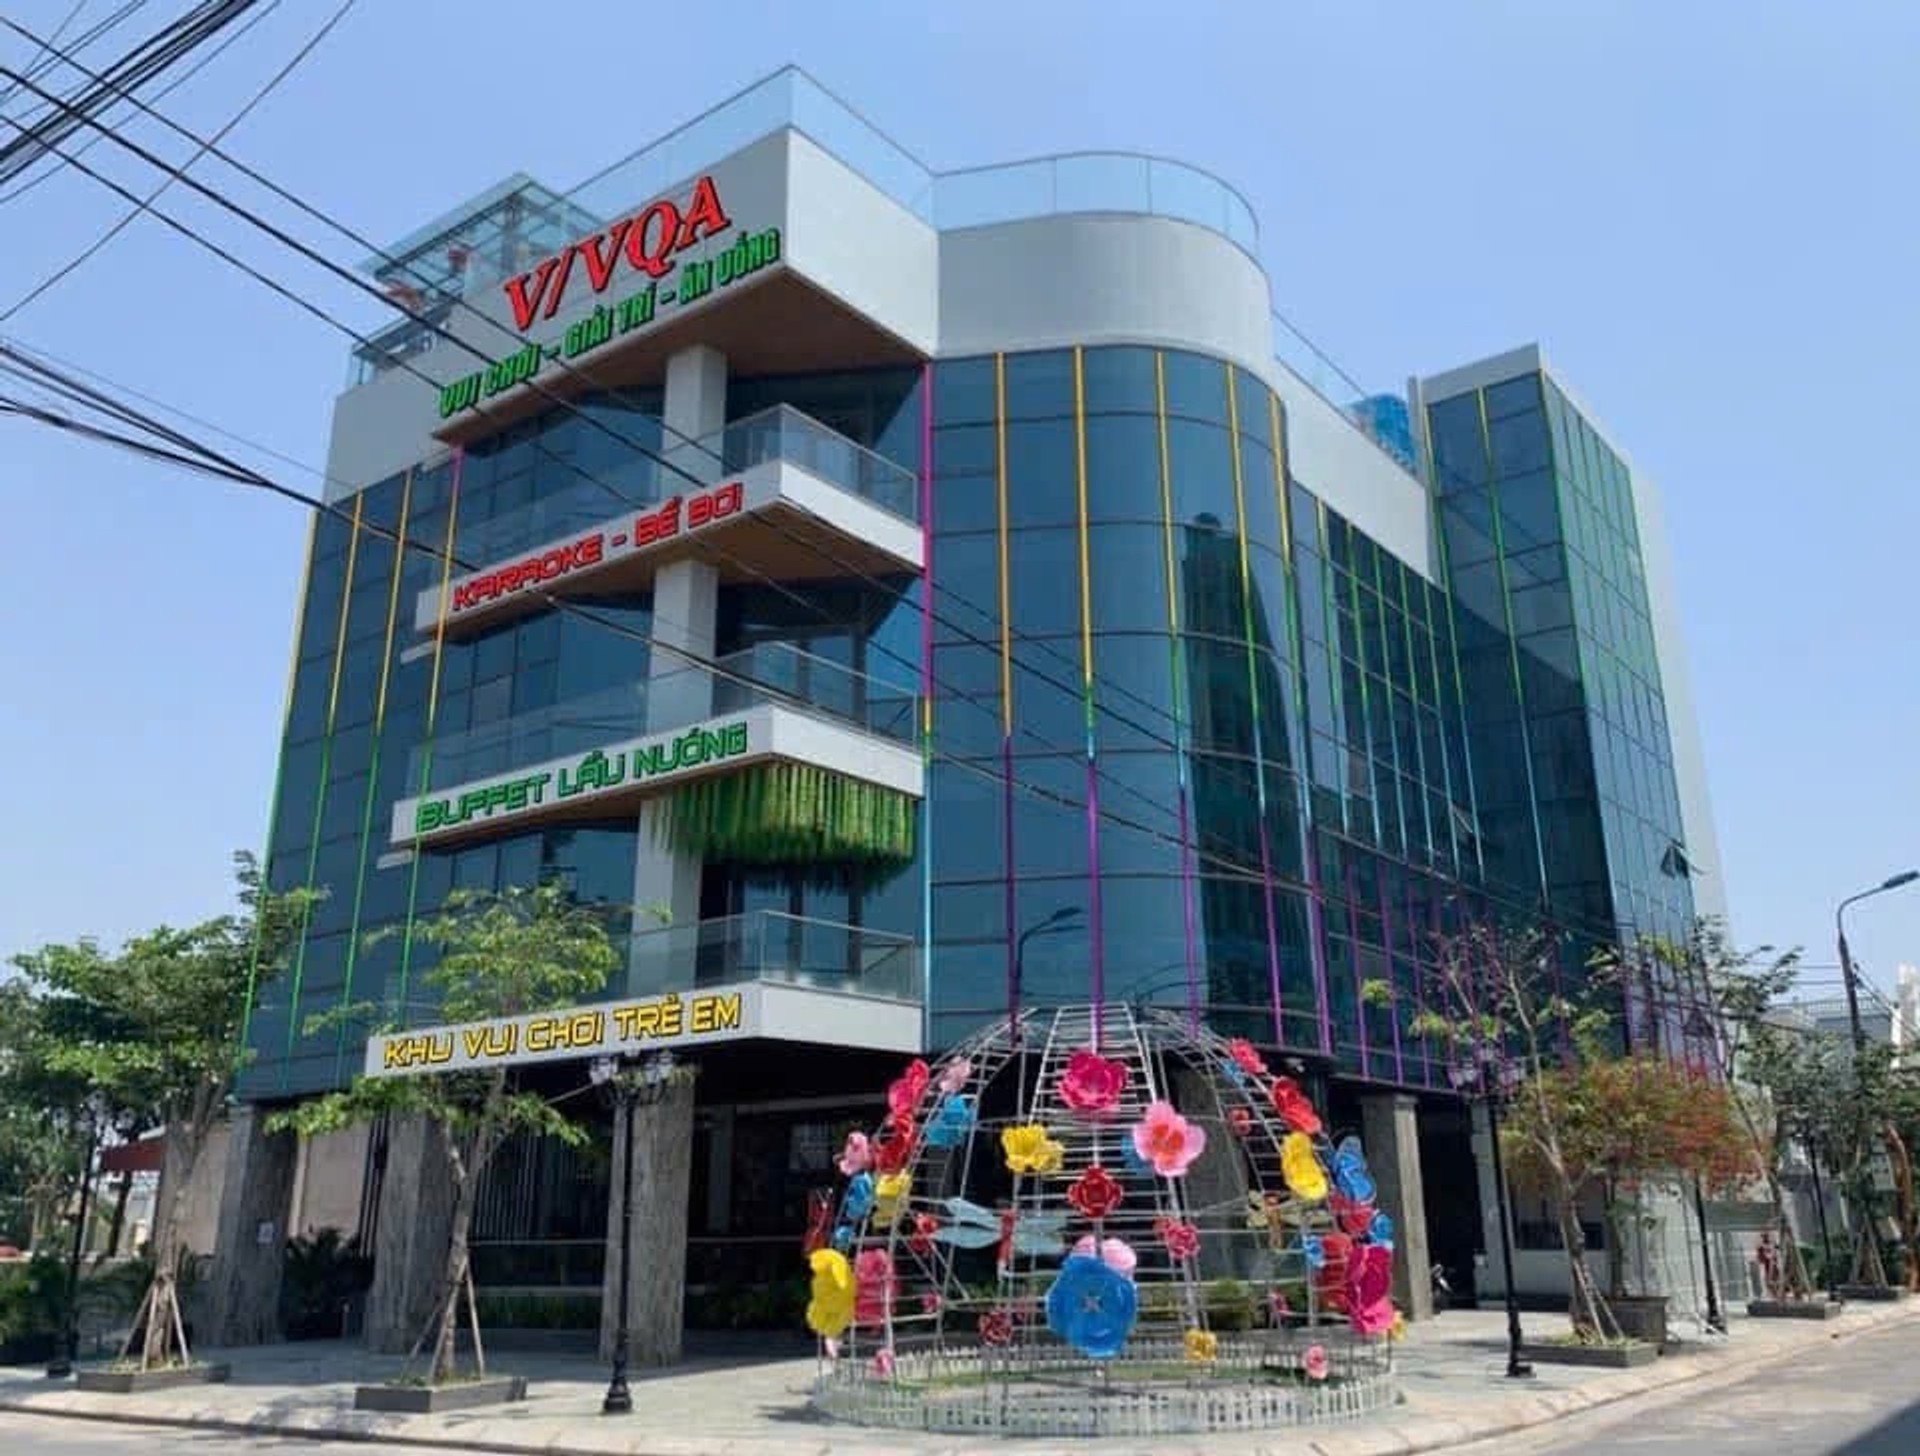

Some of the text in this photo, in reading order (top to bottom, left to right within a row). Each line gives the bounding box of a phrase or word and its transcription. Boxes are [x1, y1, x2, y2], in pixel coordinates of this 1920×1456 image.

[439, 373, 481, 418] VUI
[616, 281, 657, 334] TRÍ
[716, 229, 780, 285] UỐNG
[453, 534, 603, 610] KARAOKE
[416, 773, 550, 832] BUFFET
[384, 1032, 453, 1067] KHU
[462, 1023, 517, 1057] VUI
[613, 994, 682, 1040] TRẺ
[690, 993, 741, 1031] EM
